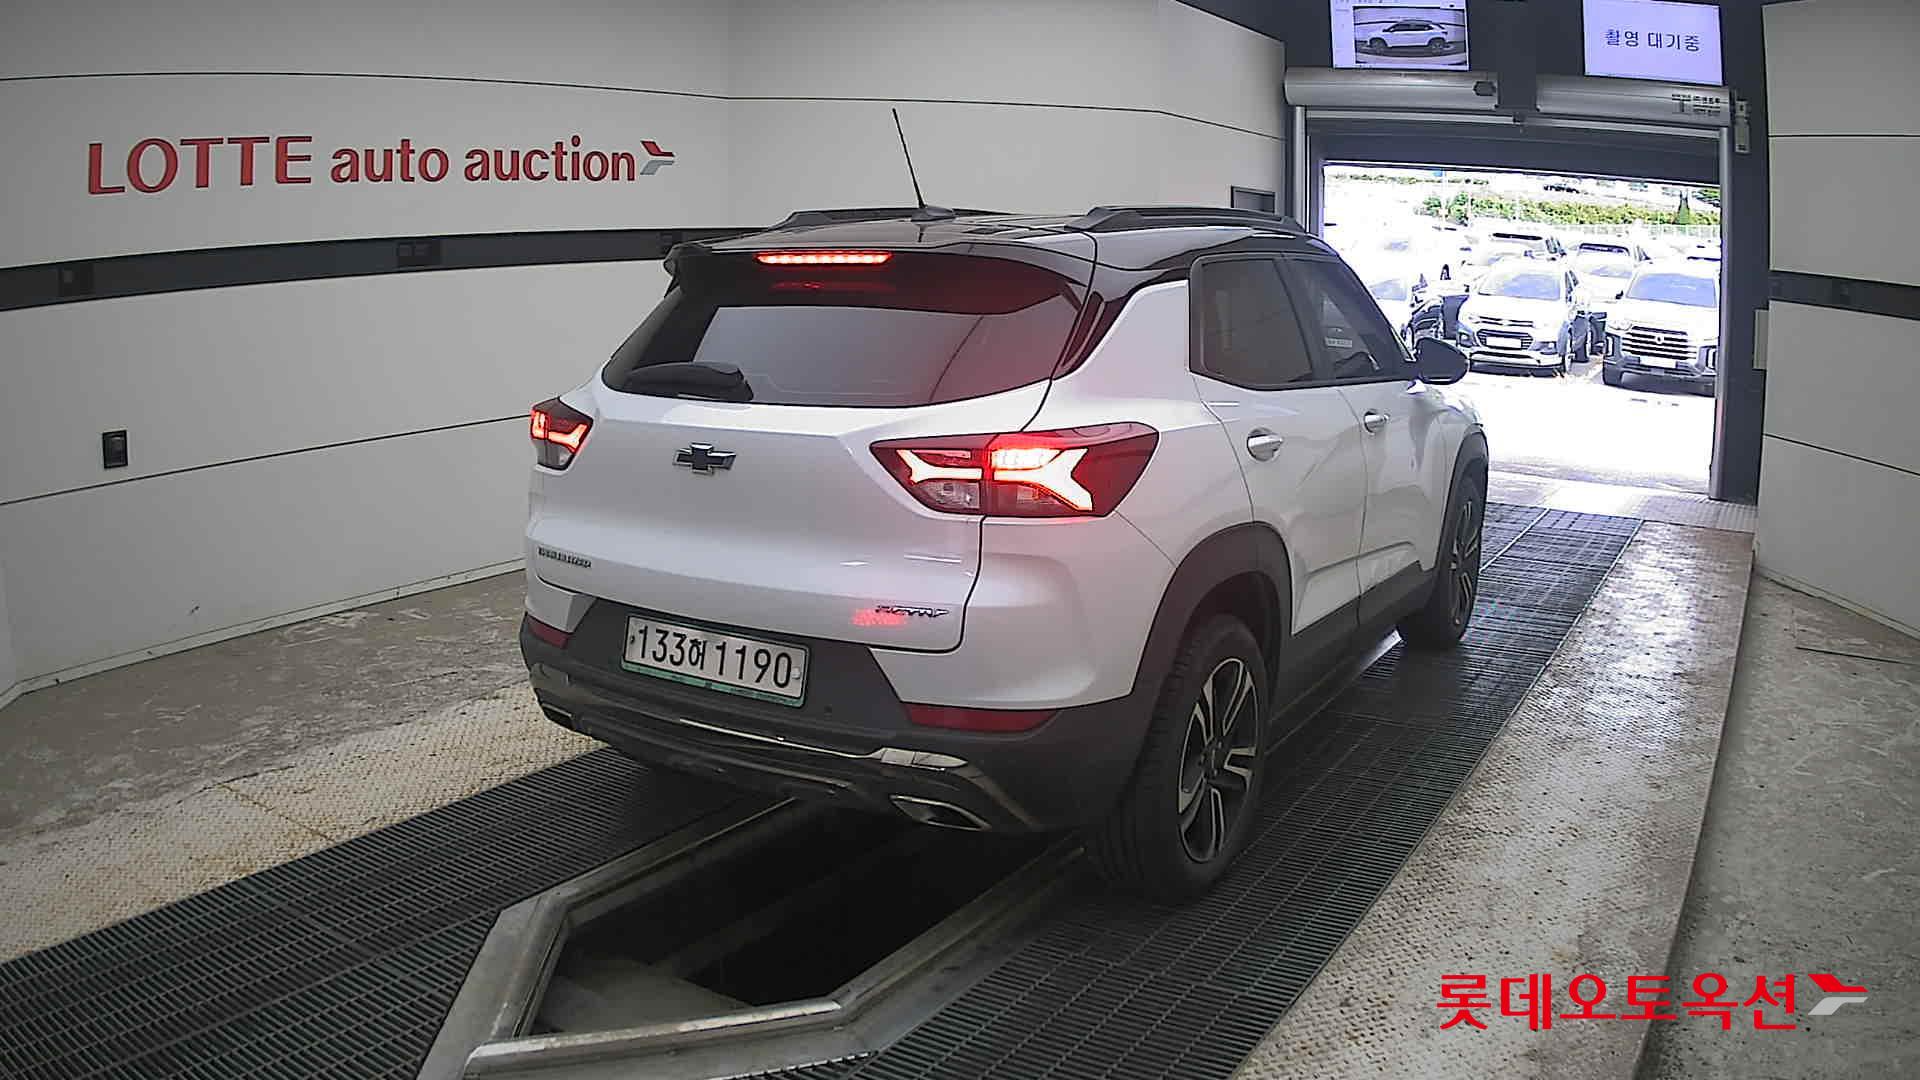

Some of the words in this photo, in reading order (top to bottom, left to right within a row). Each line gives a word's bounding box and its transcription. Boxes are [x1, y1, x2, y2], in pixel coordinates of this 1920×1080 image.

[1604, 28, 1640, 48] 촬영
[1647, 32, 1701, 52] 대기중
[88, 135, 313, 195] LOTTE
[330, 138, 450, 183] auto
[463, 135, 638, 182] auction
